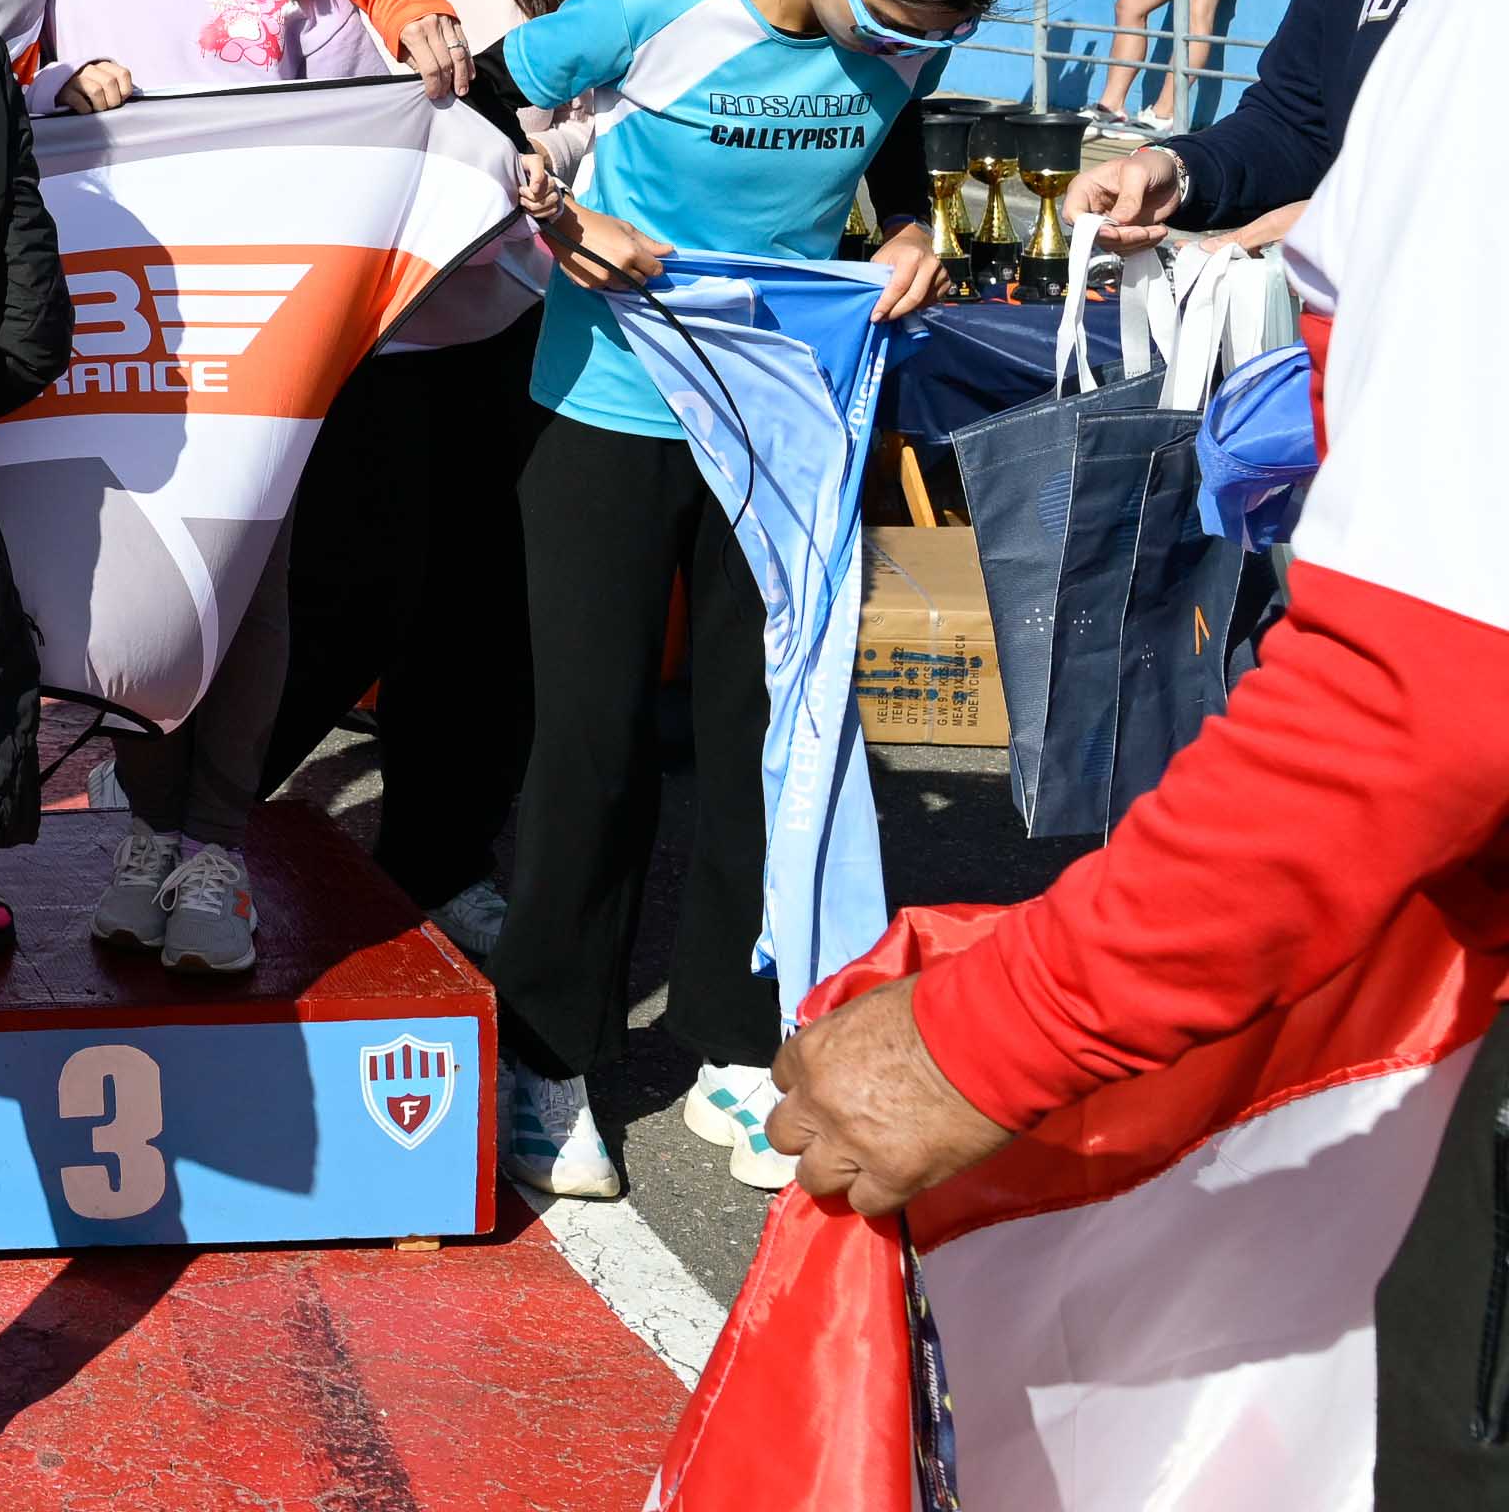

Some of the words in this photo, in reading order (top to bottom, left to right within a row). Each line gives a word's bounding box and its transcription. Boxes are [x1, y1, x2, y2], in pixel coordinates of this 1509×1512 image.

[709, 92, 873, 118] ROSARIO
[709, 124, 866, 150] CALLEYPISTA
[892, 701, 903, 725] ITEM
[907, 703, 918, 725] QTY:
[967, 700, 979, 727] MADE
[398, 1097, 422, 1128] F
[57, 1044, 166, 1220] 3
